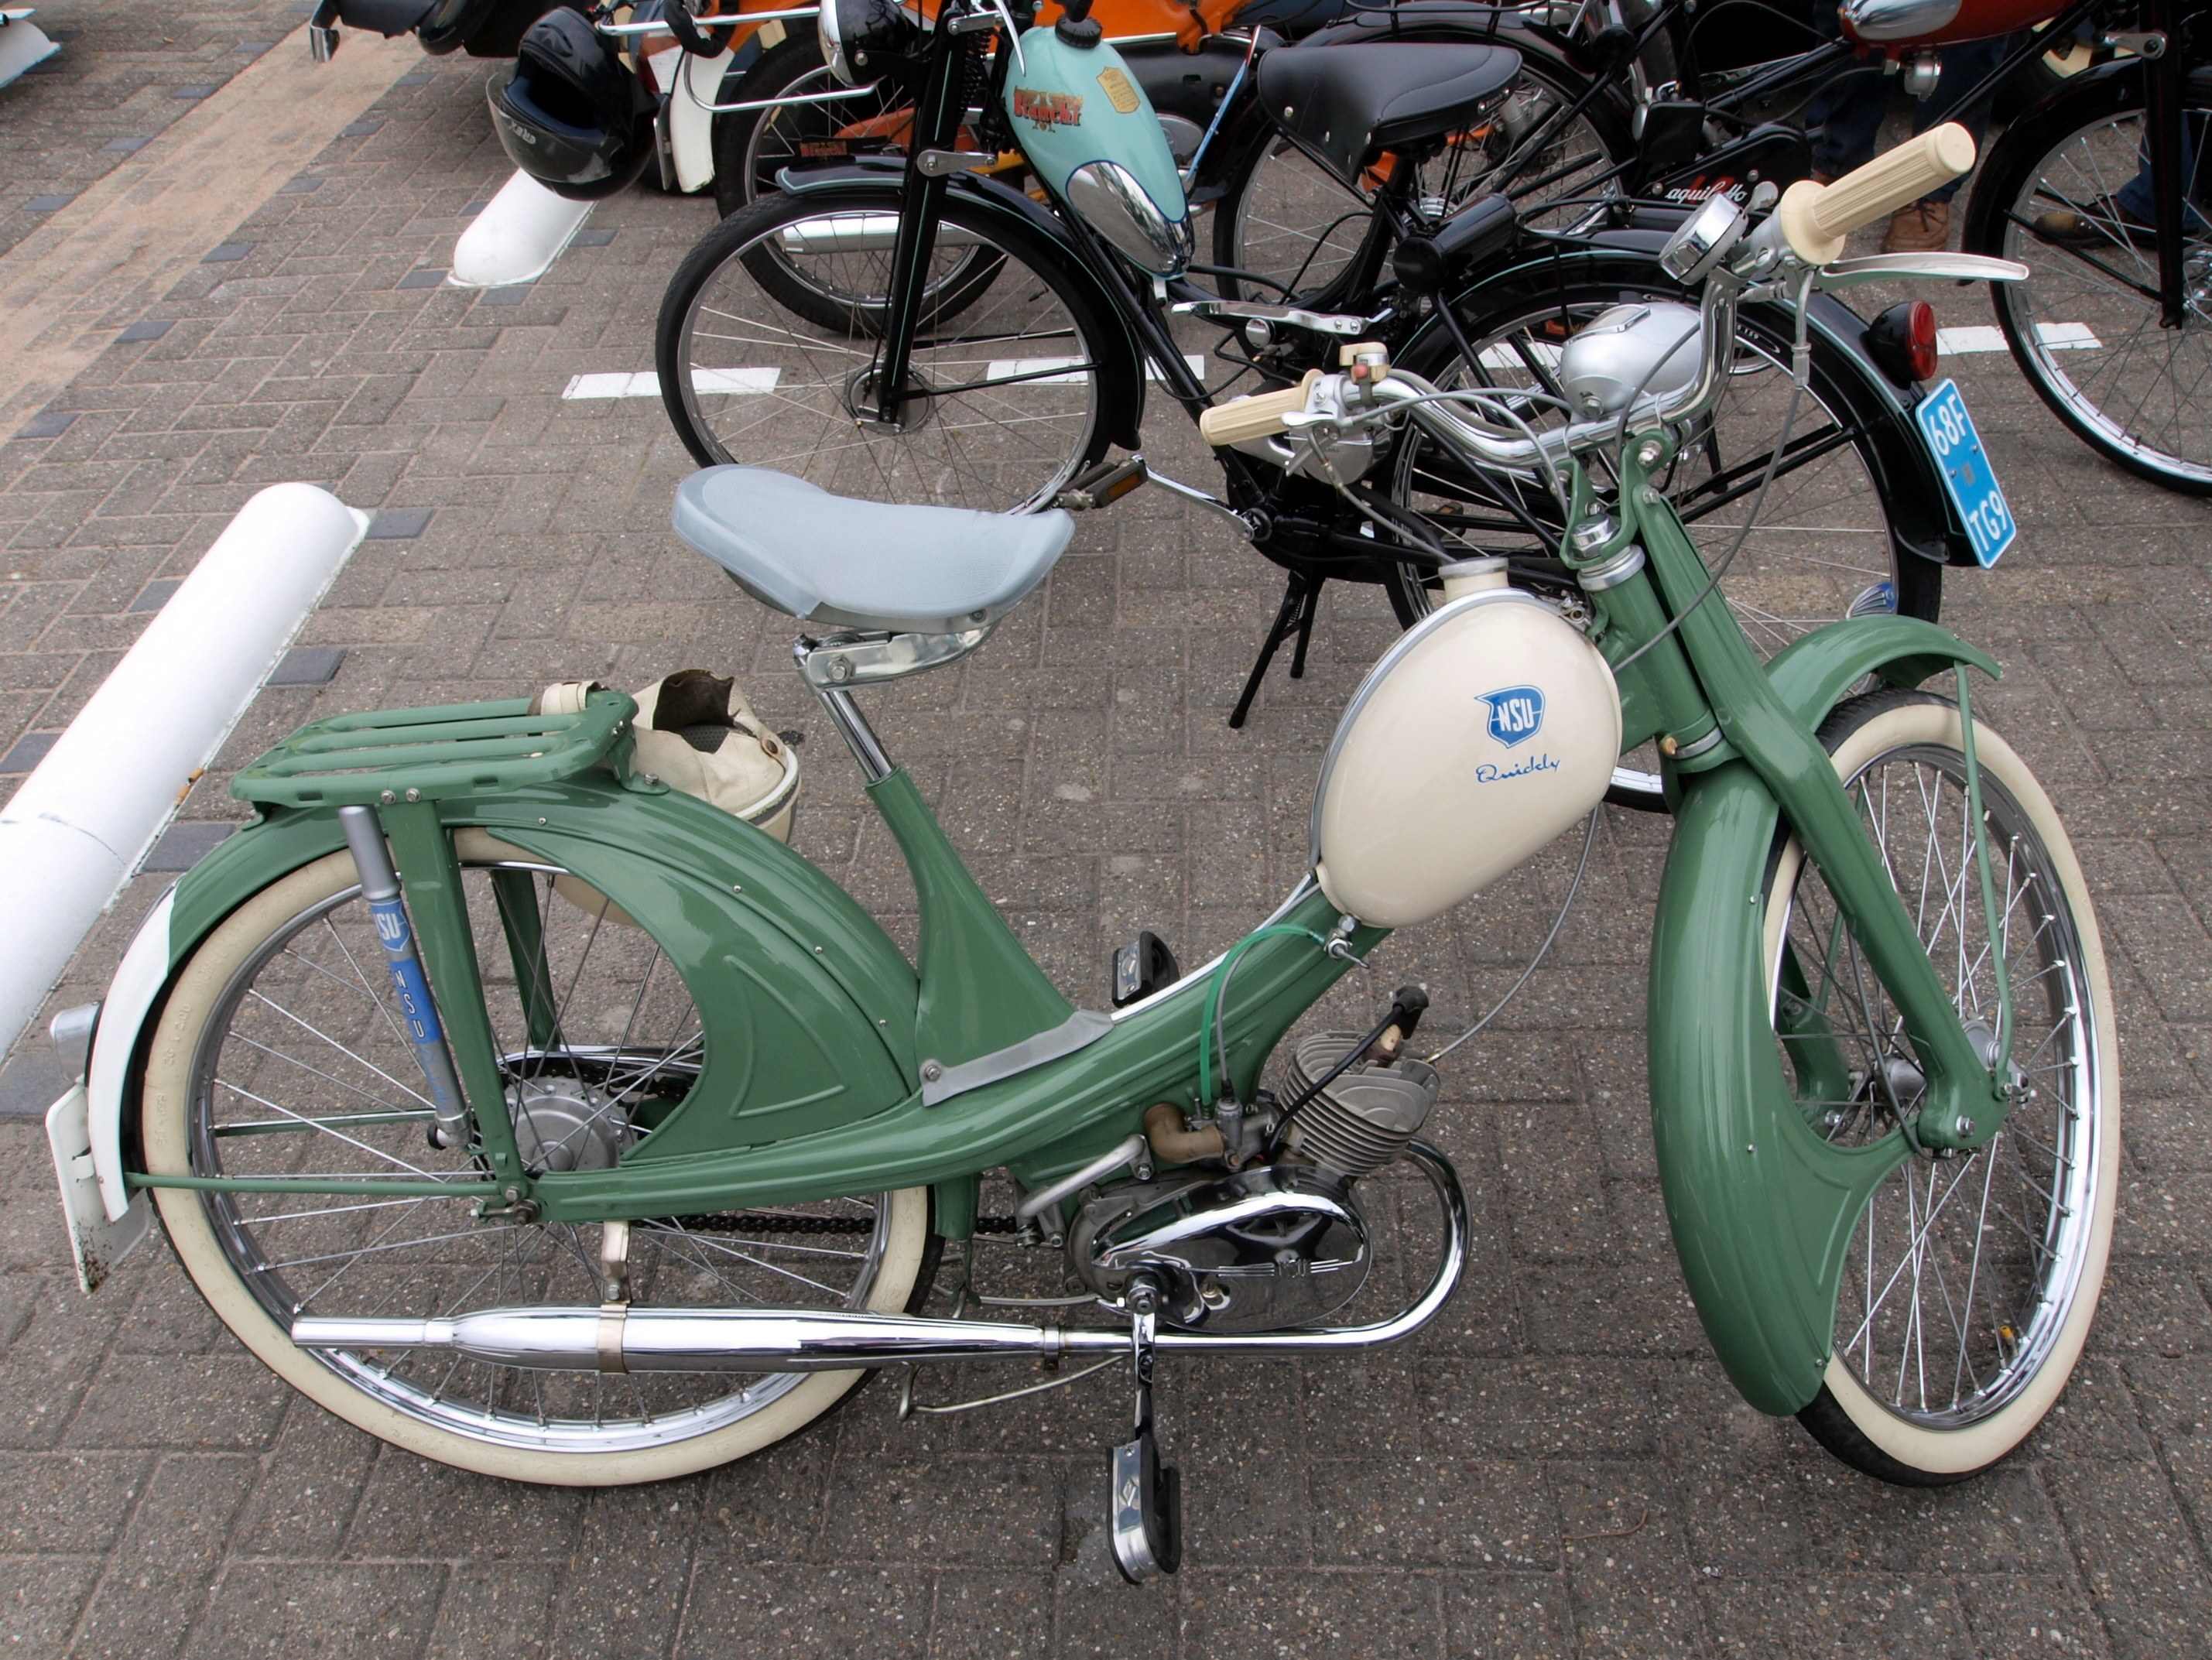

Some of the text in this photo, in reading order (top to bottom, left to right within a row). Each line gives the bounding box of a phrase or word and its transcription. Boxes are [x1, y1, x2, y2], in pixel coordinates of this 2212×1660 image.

[1013, 93, 1081, 126] Bianchi
[1930, 393, 1967, 456] 68F
[1968, 490, 2008, 552] TG9
[1497, 698, 1535, 732] NSU
[1475, 753, 1560, 783] Quickly
[373, 912, 402, 940] SU
[395, 969, 425, 1038] NSU
